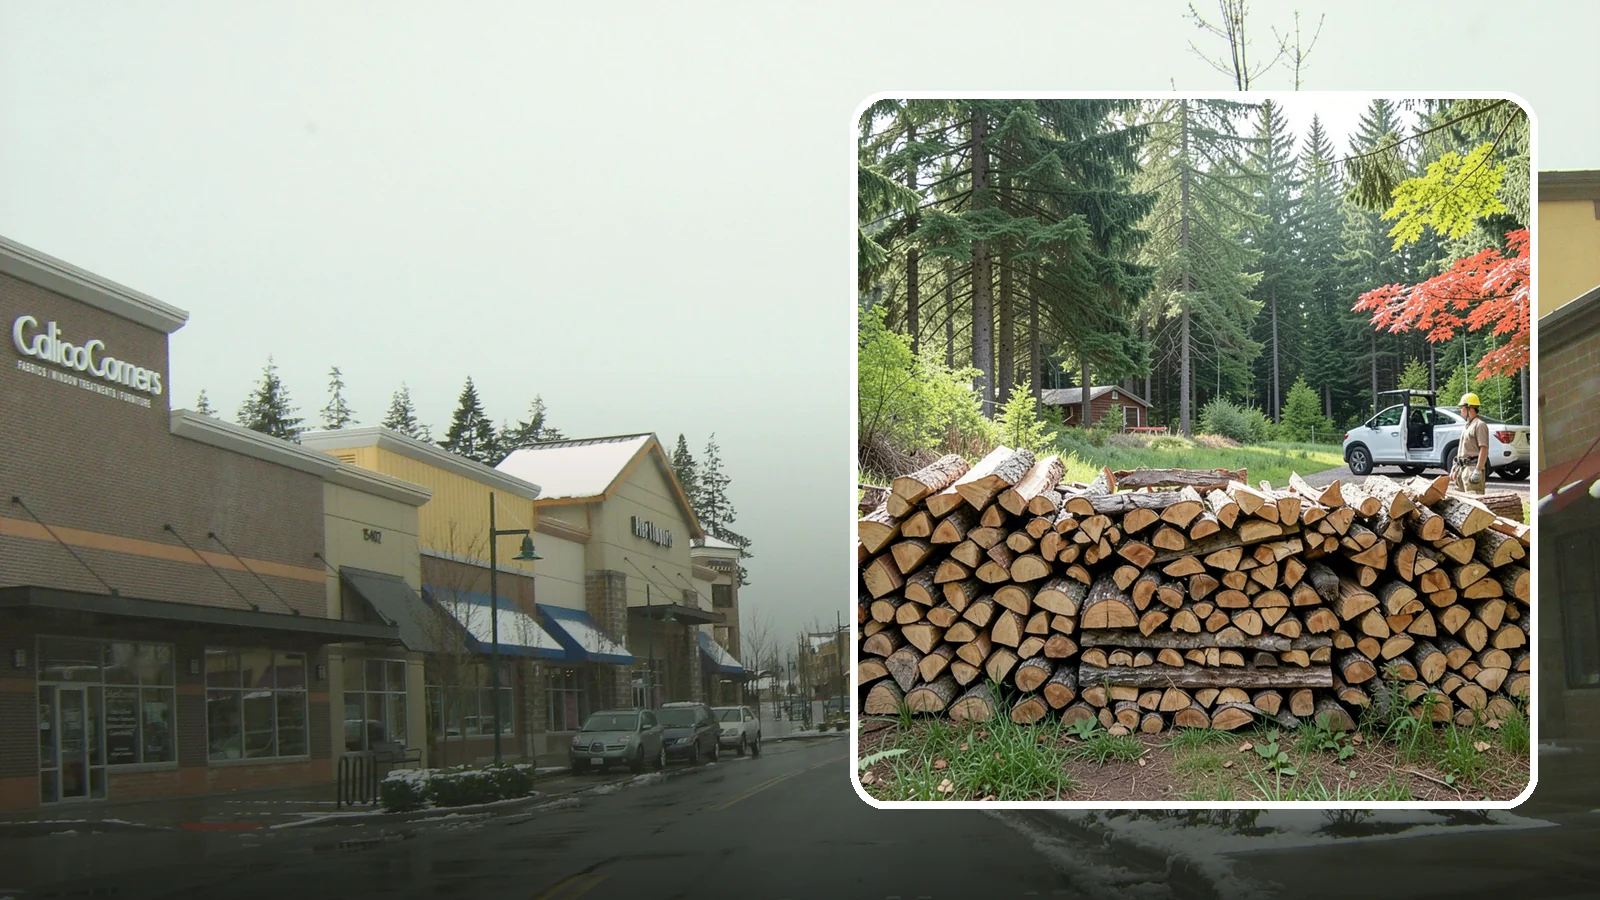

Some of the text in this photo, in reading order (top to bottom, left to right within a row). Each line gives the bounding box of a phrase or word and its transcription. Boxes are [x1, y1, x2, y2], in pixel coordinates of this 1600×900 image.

[17, 360, 47, 376] FABRICS
[51, 370, 78, 386] WINDOW
[79, 379, 117, 398] TREATMENTS
[120, 391, 151, 408] FURNITURE
